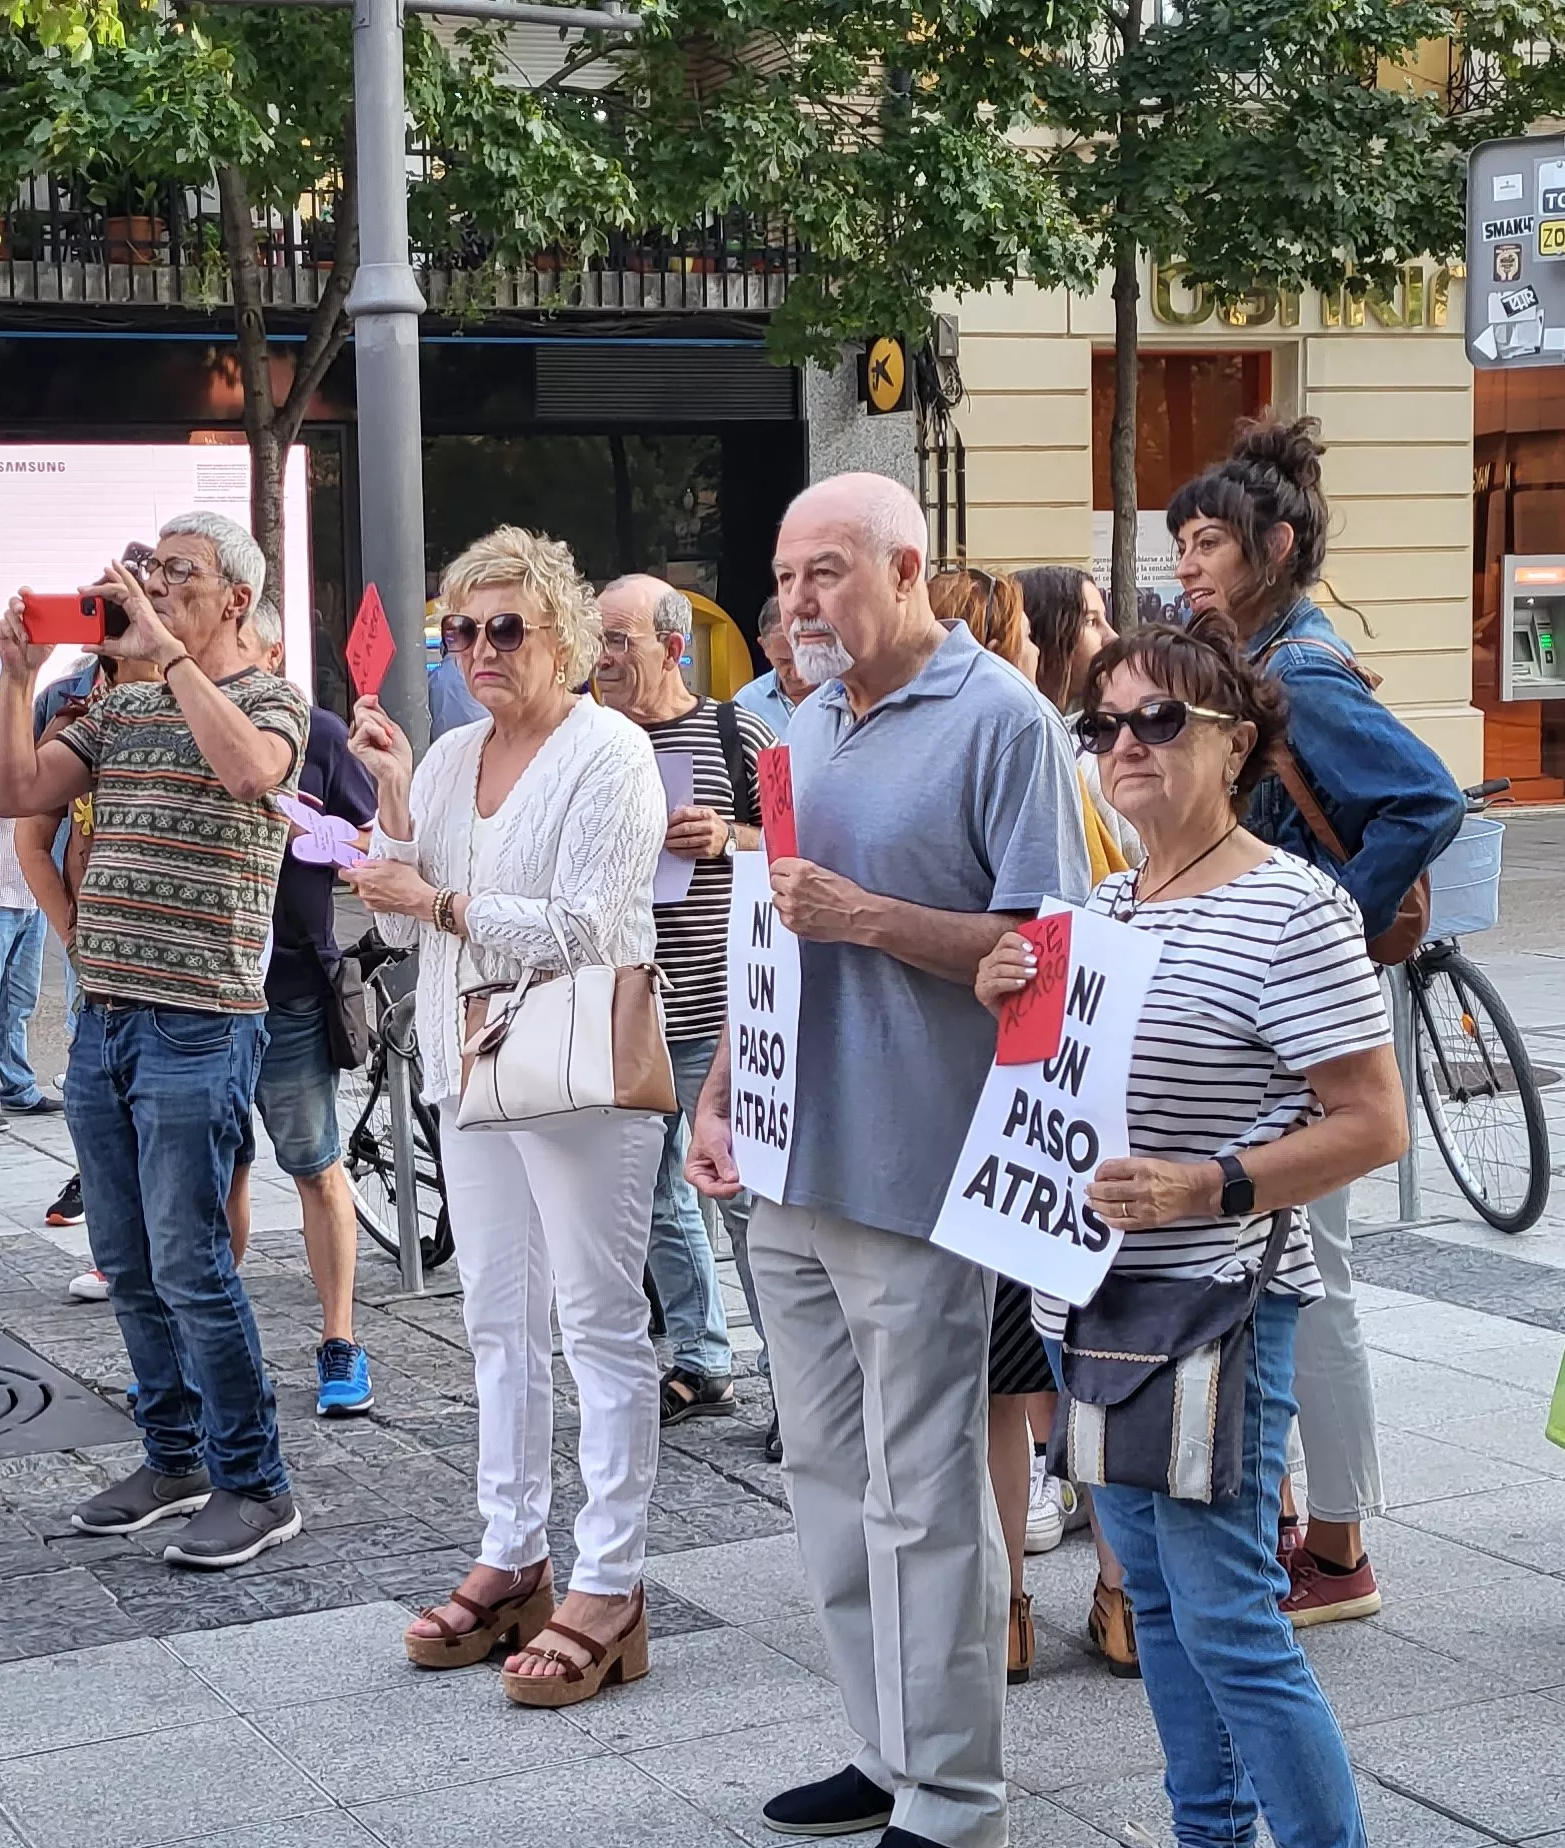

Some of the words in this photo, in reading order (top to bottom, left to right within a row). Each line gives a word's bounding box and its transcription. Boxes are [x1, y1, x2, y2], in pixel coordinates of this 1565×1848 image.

[752, 901, 773, 950] NI
[748, 962, 775, 1014] UN
[1066, 964, 1106, 1028] NI
[739, 1023, 785, 1082] PASO
[1043, 1036, 1092, 1098] UN
[734, 1084, 789, 1152] ATRÁS
[1003, 1087, 1100, 1175] PASO
[962, 1153, 1112, 1255] ATRÁS
